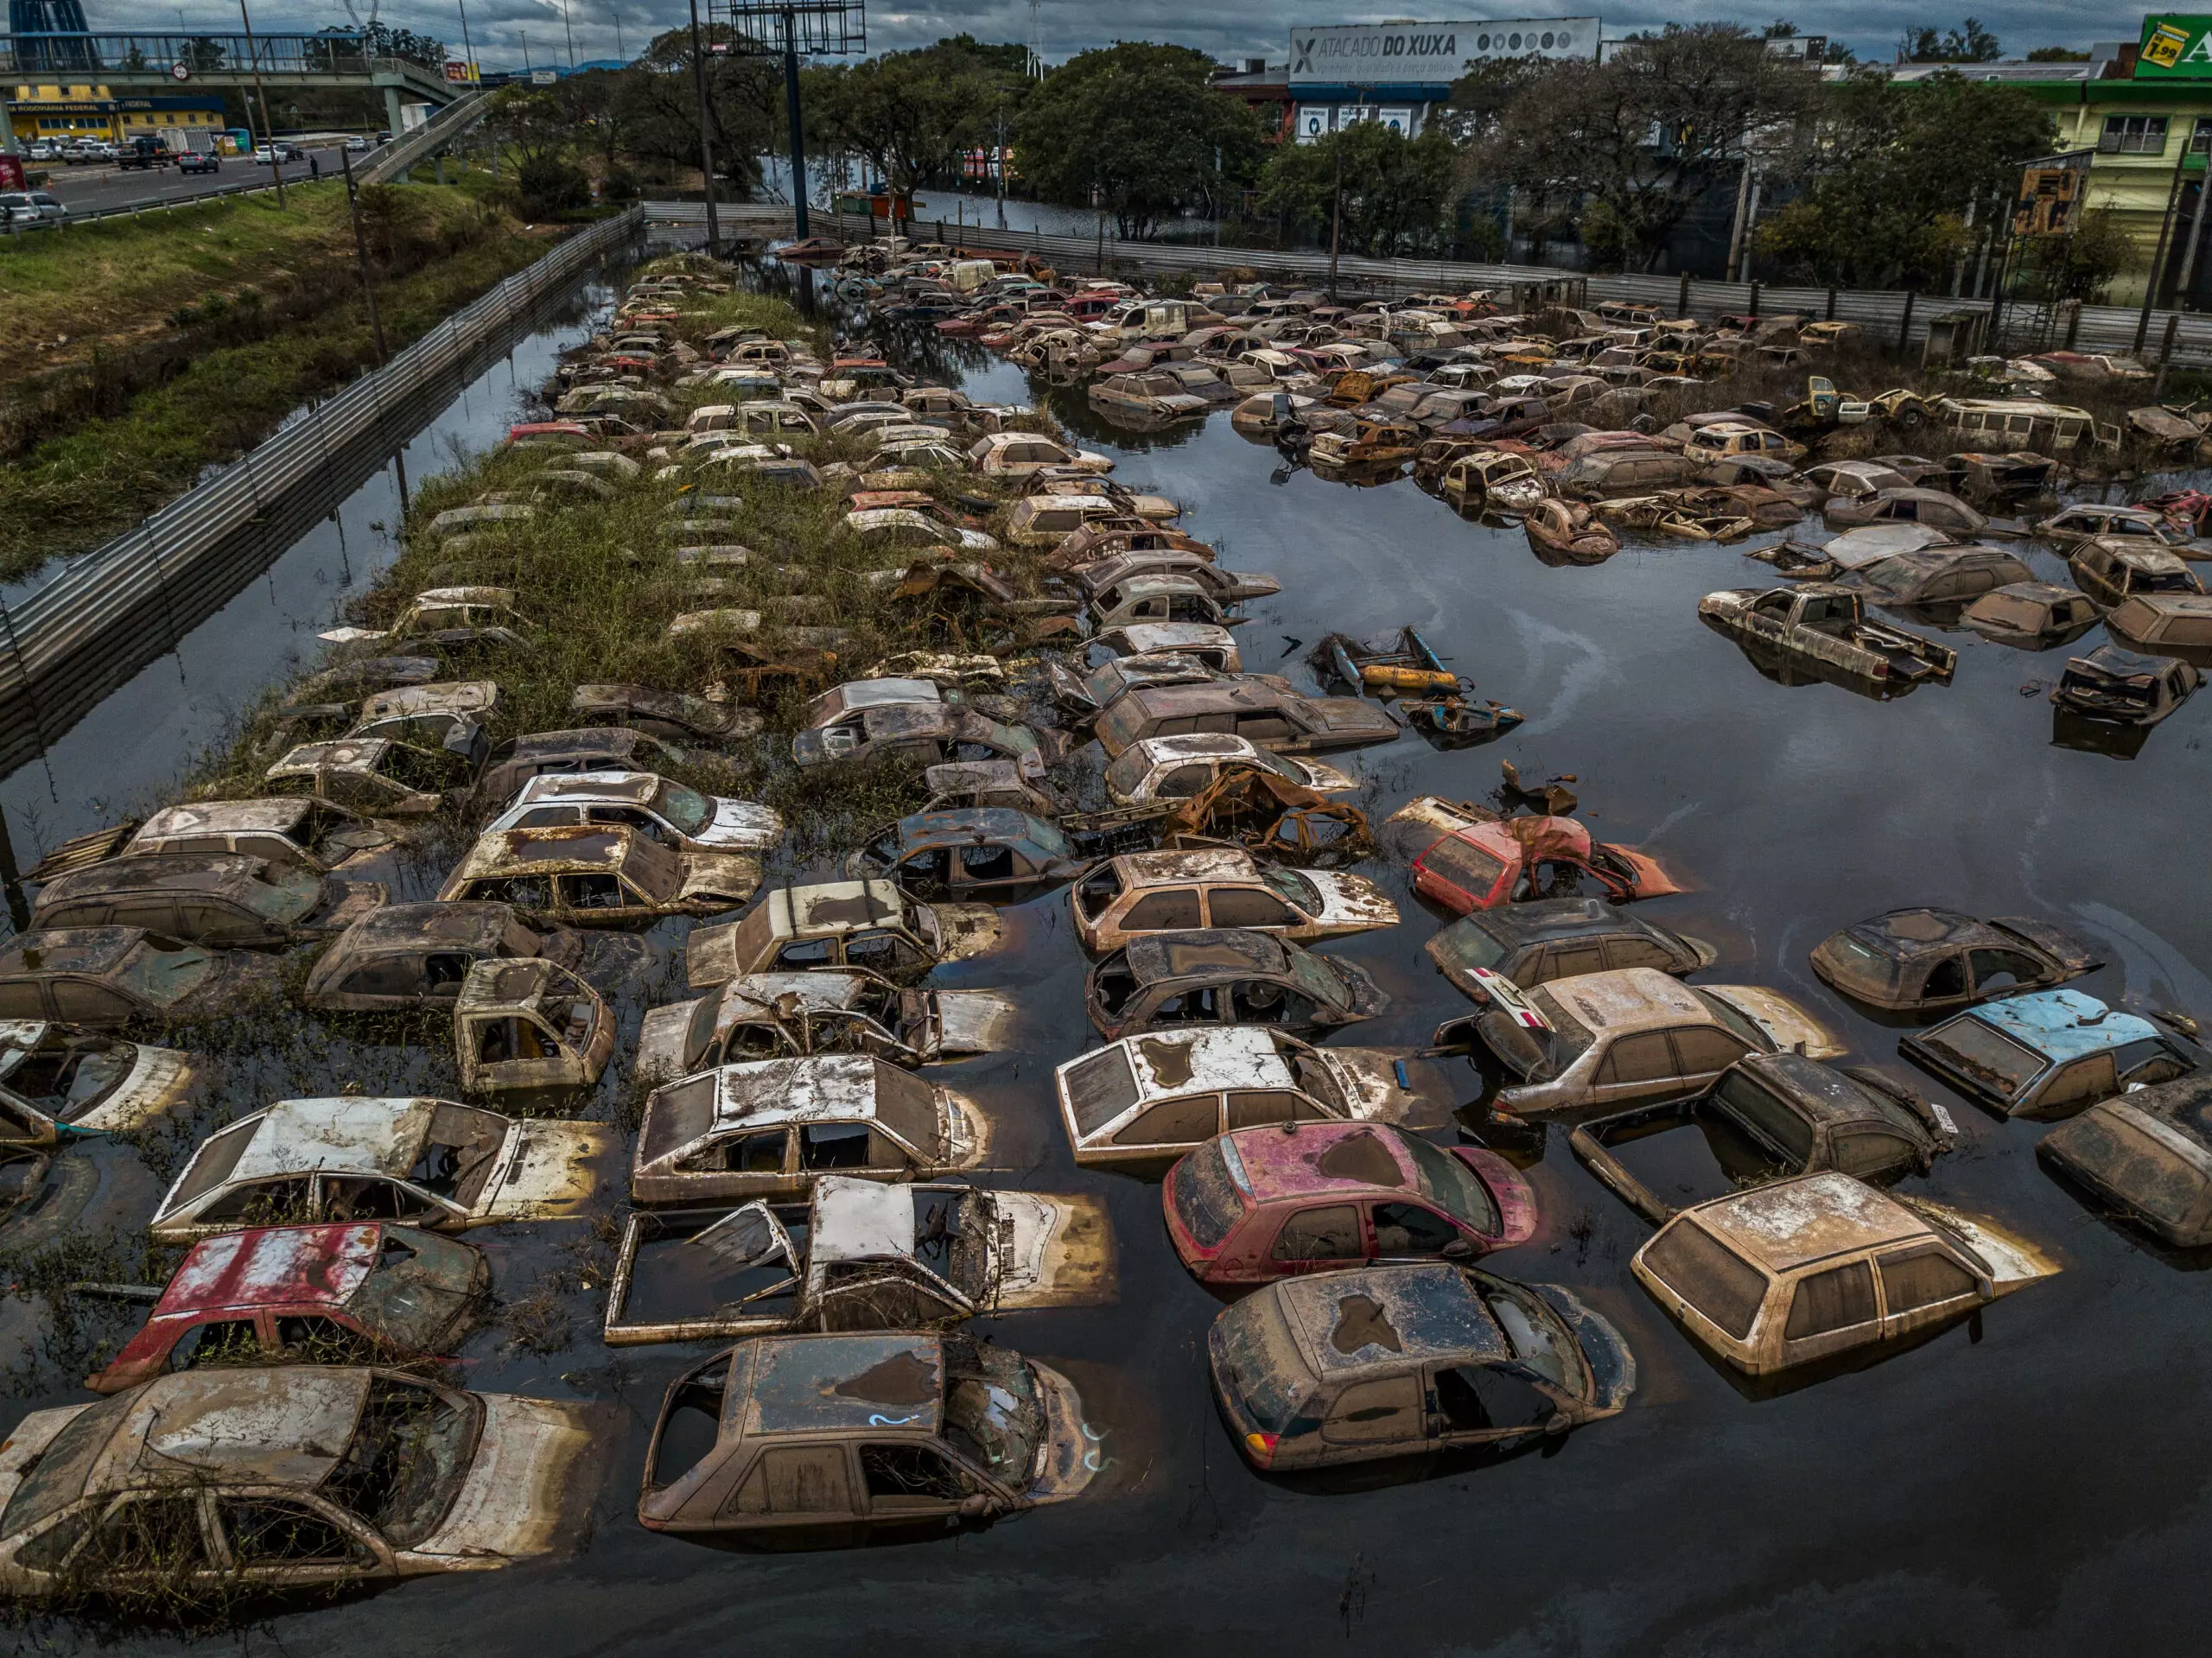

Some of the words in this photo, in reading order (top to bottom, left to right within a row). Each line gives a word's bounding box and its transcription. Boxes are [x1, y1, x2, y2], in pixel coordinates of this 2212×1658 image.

[1318, 36, 1381, 58] ATACADO
[1382, 35, 1406, 56] DO
[1407, 34, 1456, 56] XUXA
